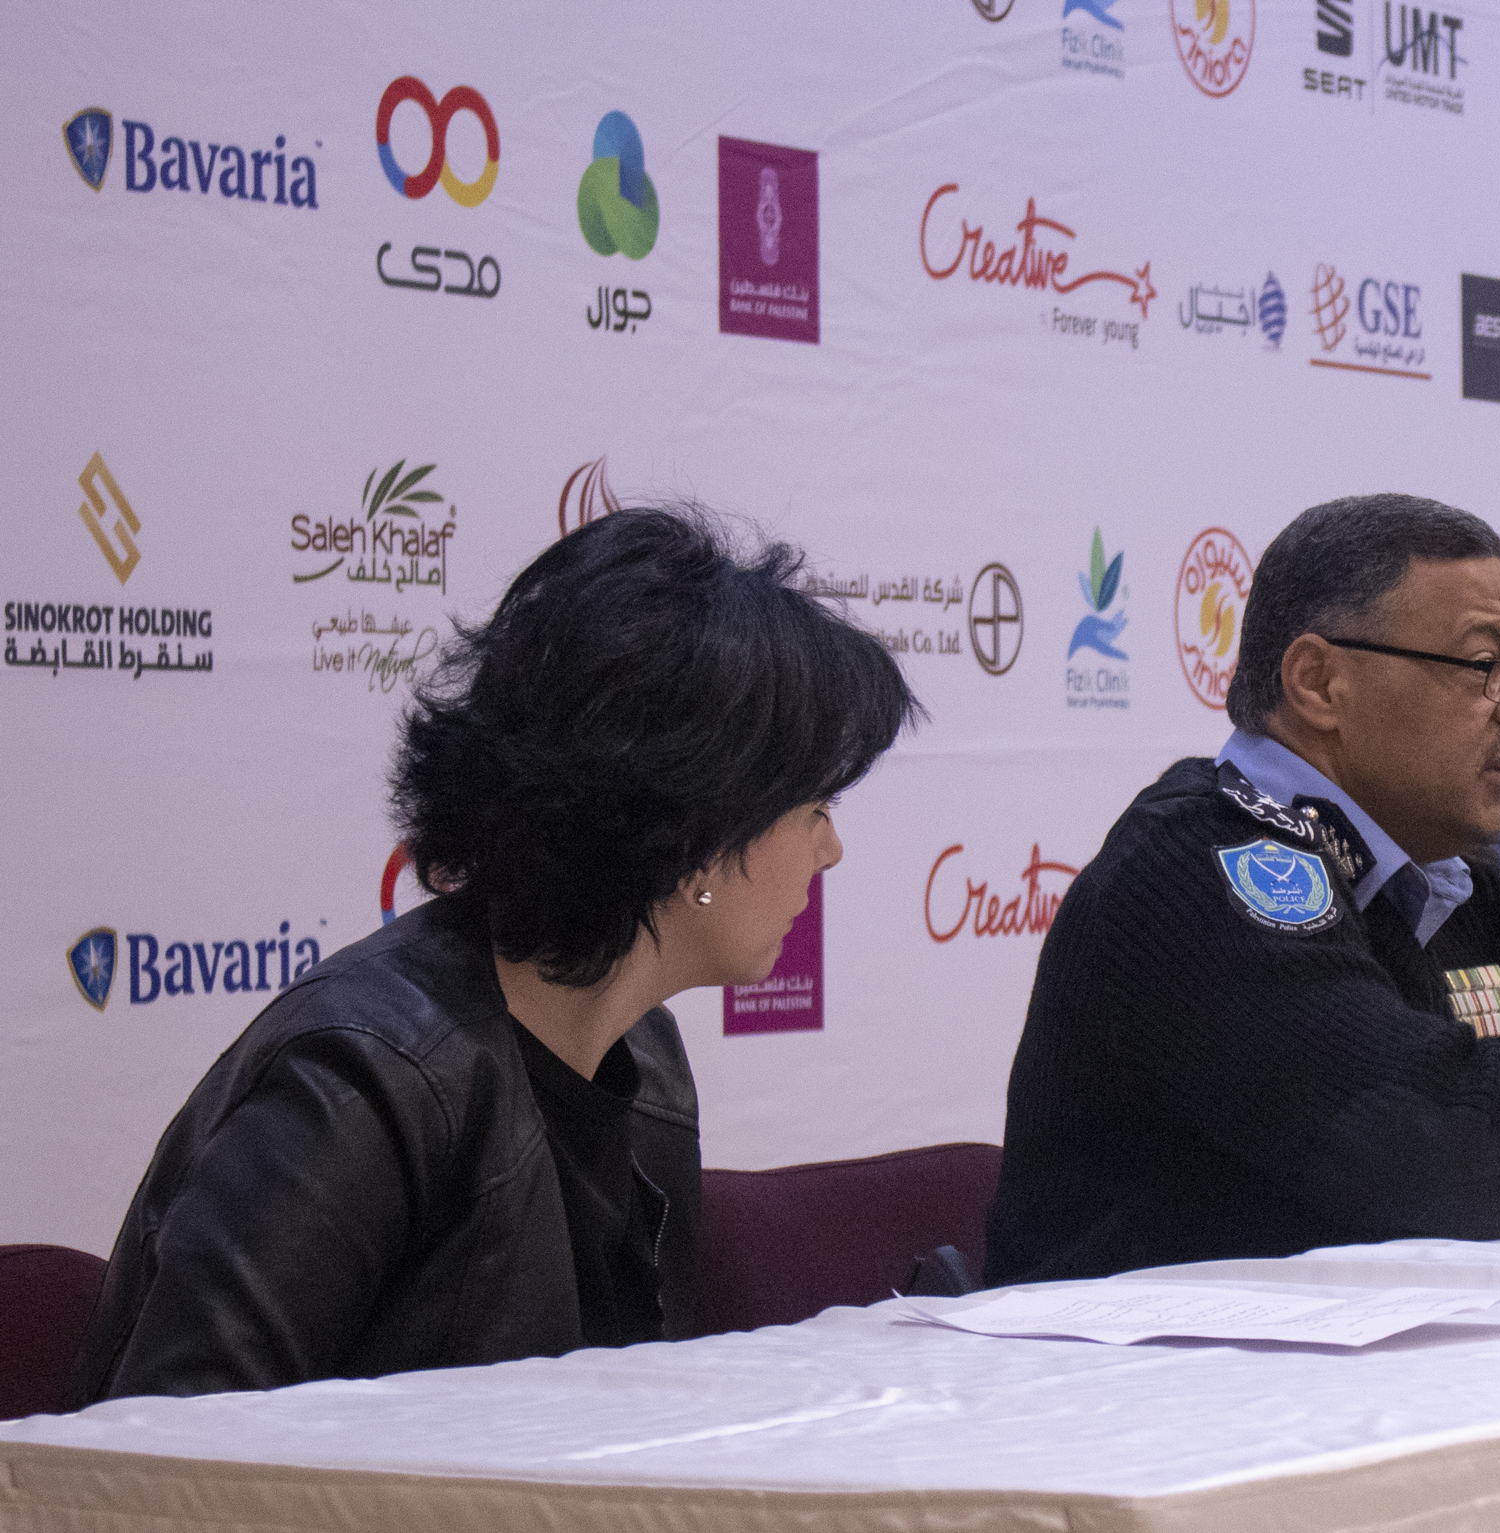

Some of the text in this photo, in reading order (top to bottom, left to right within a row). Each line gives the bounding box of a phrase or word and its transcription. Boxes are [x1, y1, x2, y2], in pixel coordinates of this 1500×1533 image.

[1385, 0, 1464, 80] UMT
[1303, 67, 1367, 101] SEAT
[122, 119, 319, 210] Bavaria
[920, 183, 1076, 294] Creative
[587, 285, 652, 334] جوال
[1053, 307, 1138, 350] Forever young
[1357, 277, 1422, 339] GSE
[291, 505, 457, 595] Saleh Khalaf
[5, 602, 213, 638] SINOKROT HOLDING
[313, 646, 344, 672] Live
[925, 843, 1079, 944] Creativ
[1279, 923, 1299, 931] Police
